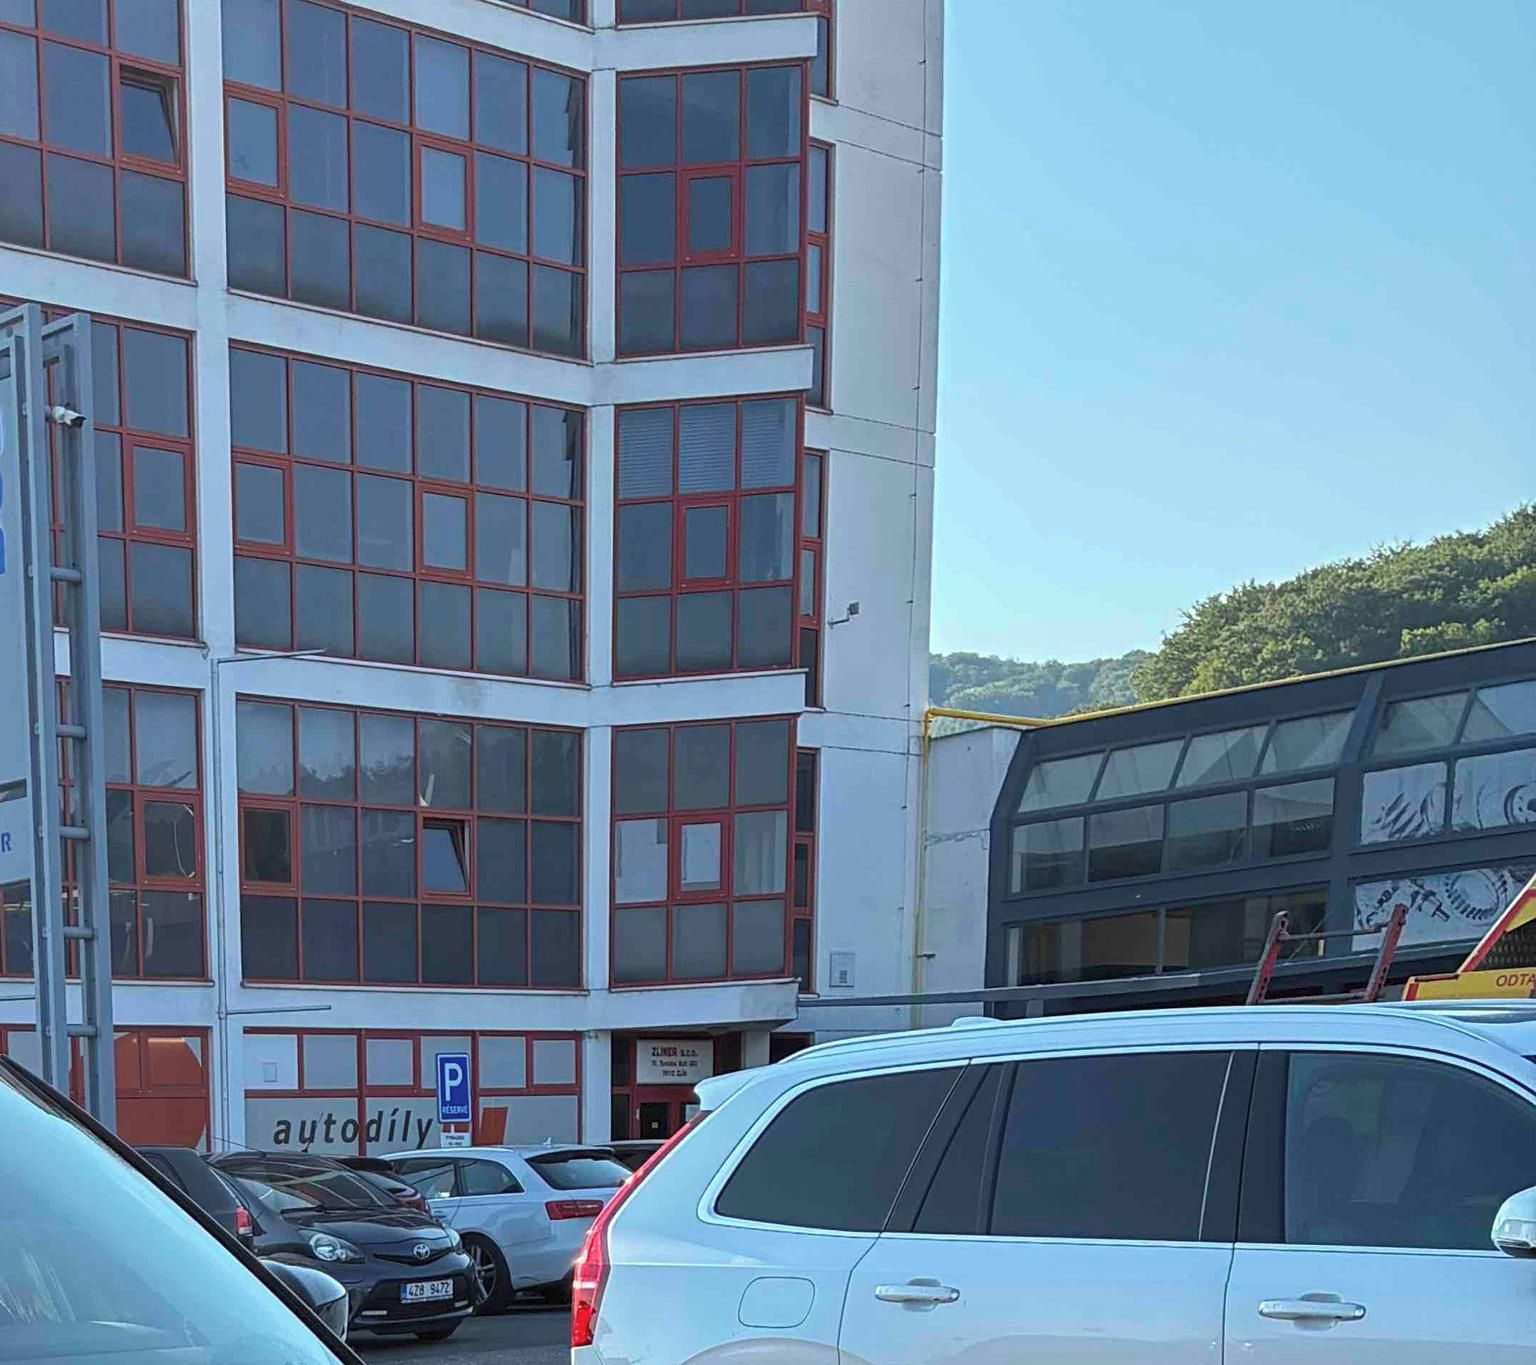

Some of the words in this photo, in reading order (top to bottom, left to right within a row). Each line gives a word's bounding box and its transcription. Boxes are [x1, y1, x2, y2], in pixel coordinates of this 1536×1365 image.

[444, 1062, 463, 1101] P
[273, 1108, 433, 1150] autodíly
[430, 1281, 450, 1294] 9472
